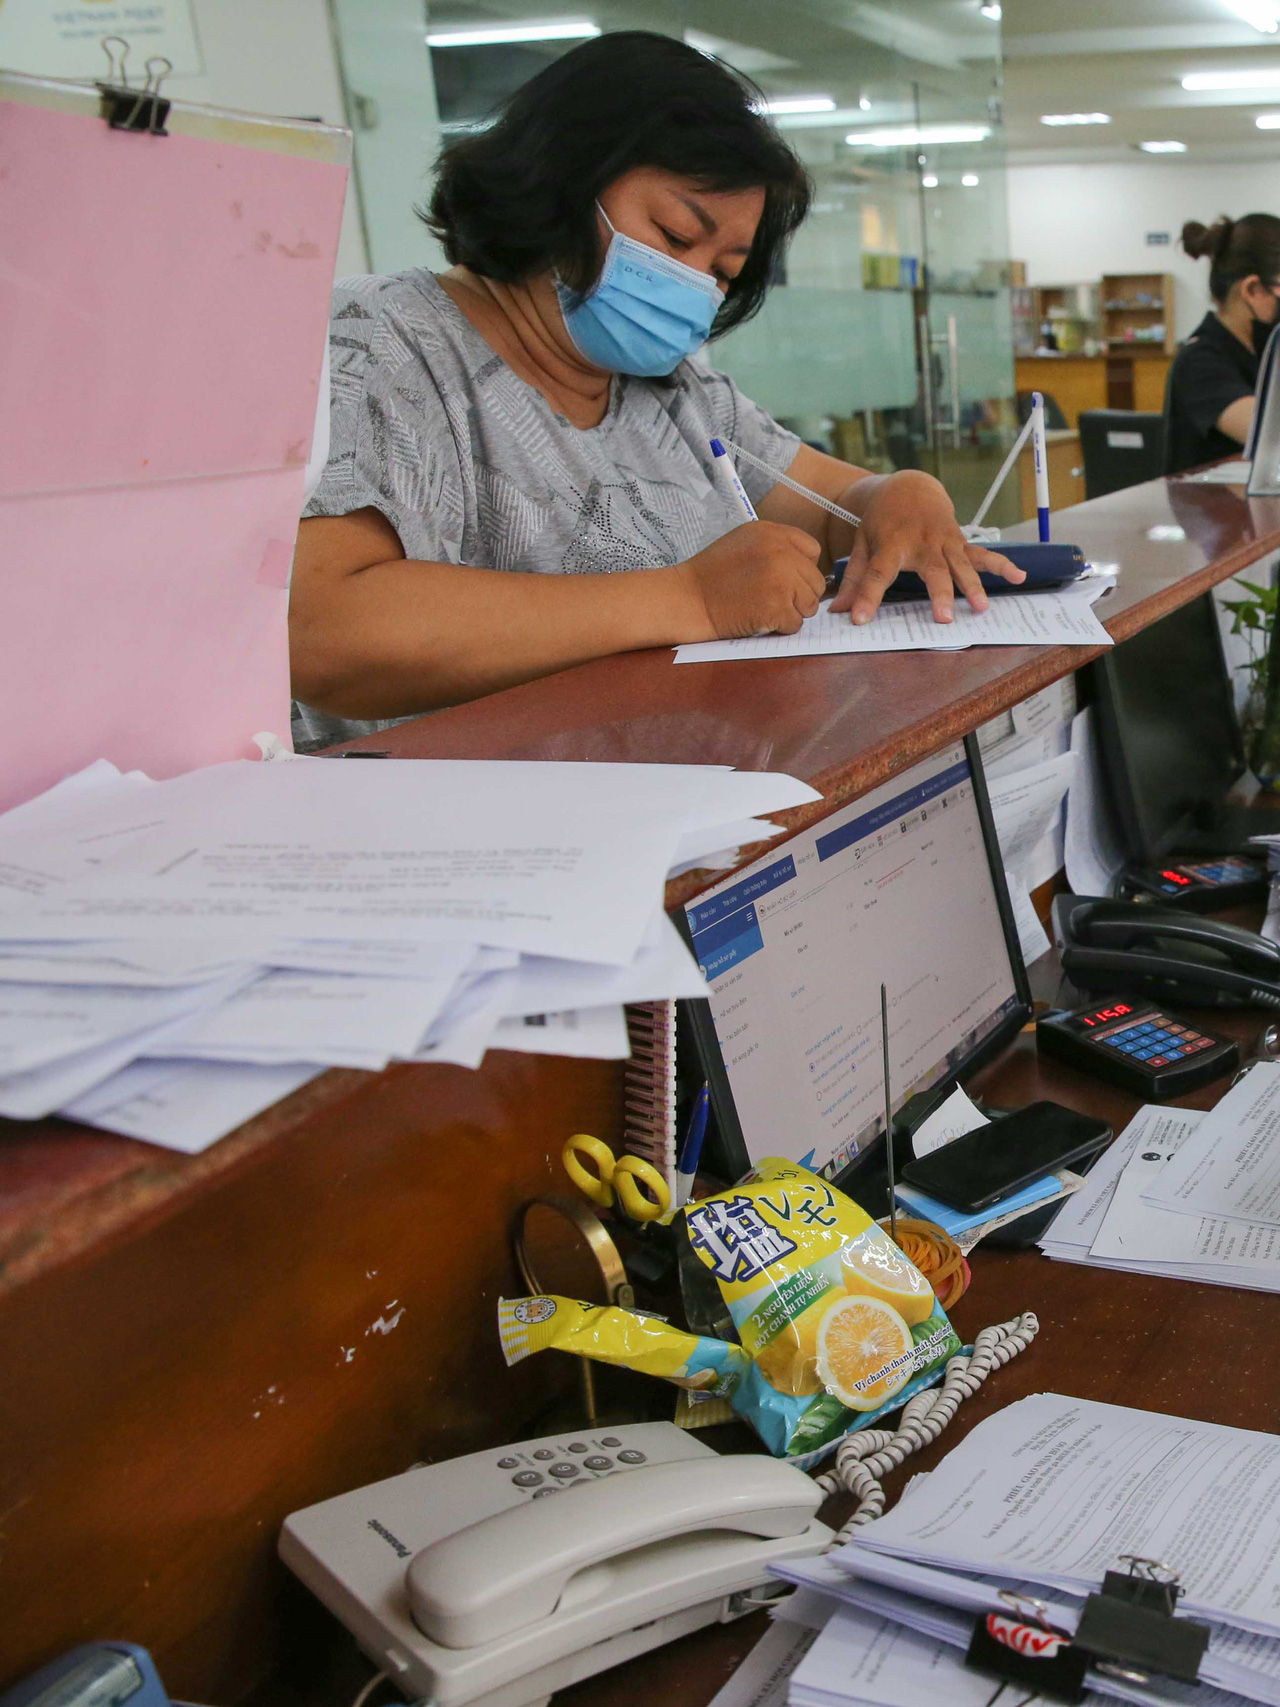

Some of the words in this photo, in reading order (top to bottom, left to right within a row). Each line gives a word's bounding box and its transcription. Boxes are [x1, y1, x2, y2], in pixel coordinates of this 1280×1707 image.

[758, 1180, 837, 1226] レモン
[752, 1314, 765, 1328] 2
[754, 1329, 771, 1350] BỘT
[769, 1304, 797, 1332] CHANH
[794, 1293, 807, 1308] TỰ
[854, 1380, 867, 1392] Vị
[866, 1363, 891, 1385] chanh
[890, 1350, 914, 1370] thanh
[367, 1518, 411, 1558] Panasonic
